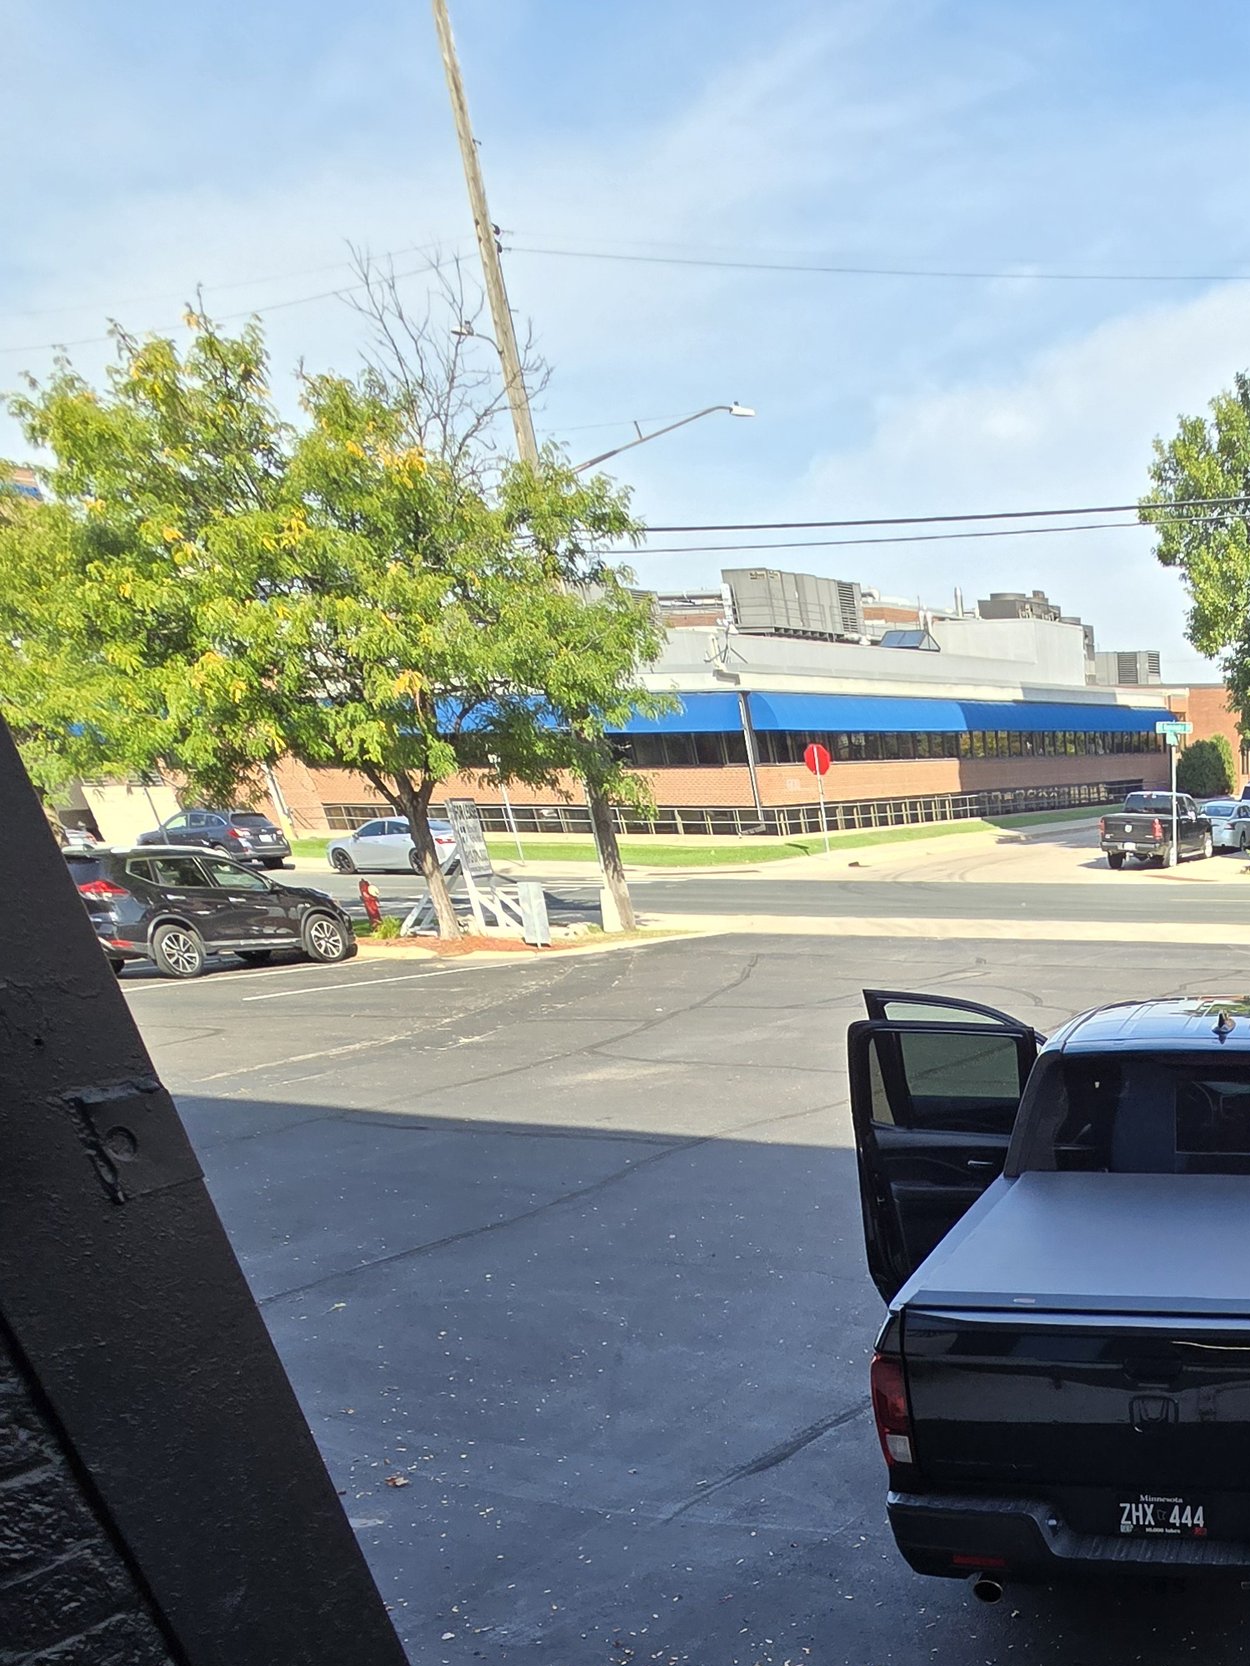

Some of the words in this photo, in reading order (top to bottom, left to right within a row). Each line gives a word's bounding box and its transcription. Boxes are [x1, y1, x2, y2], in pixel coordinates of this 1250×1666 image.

[1139, 1494, 1183, 1503] Minnesota
[1119, 1503, 1155, 1525] ZHX
[1169, 1505, 1204, 1527] 444
